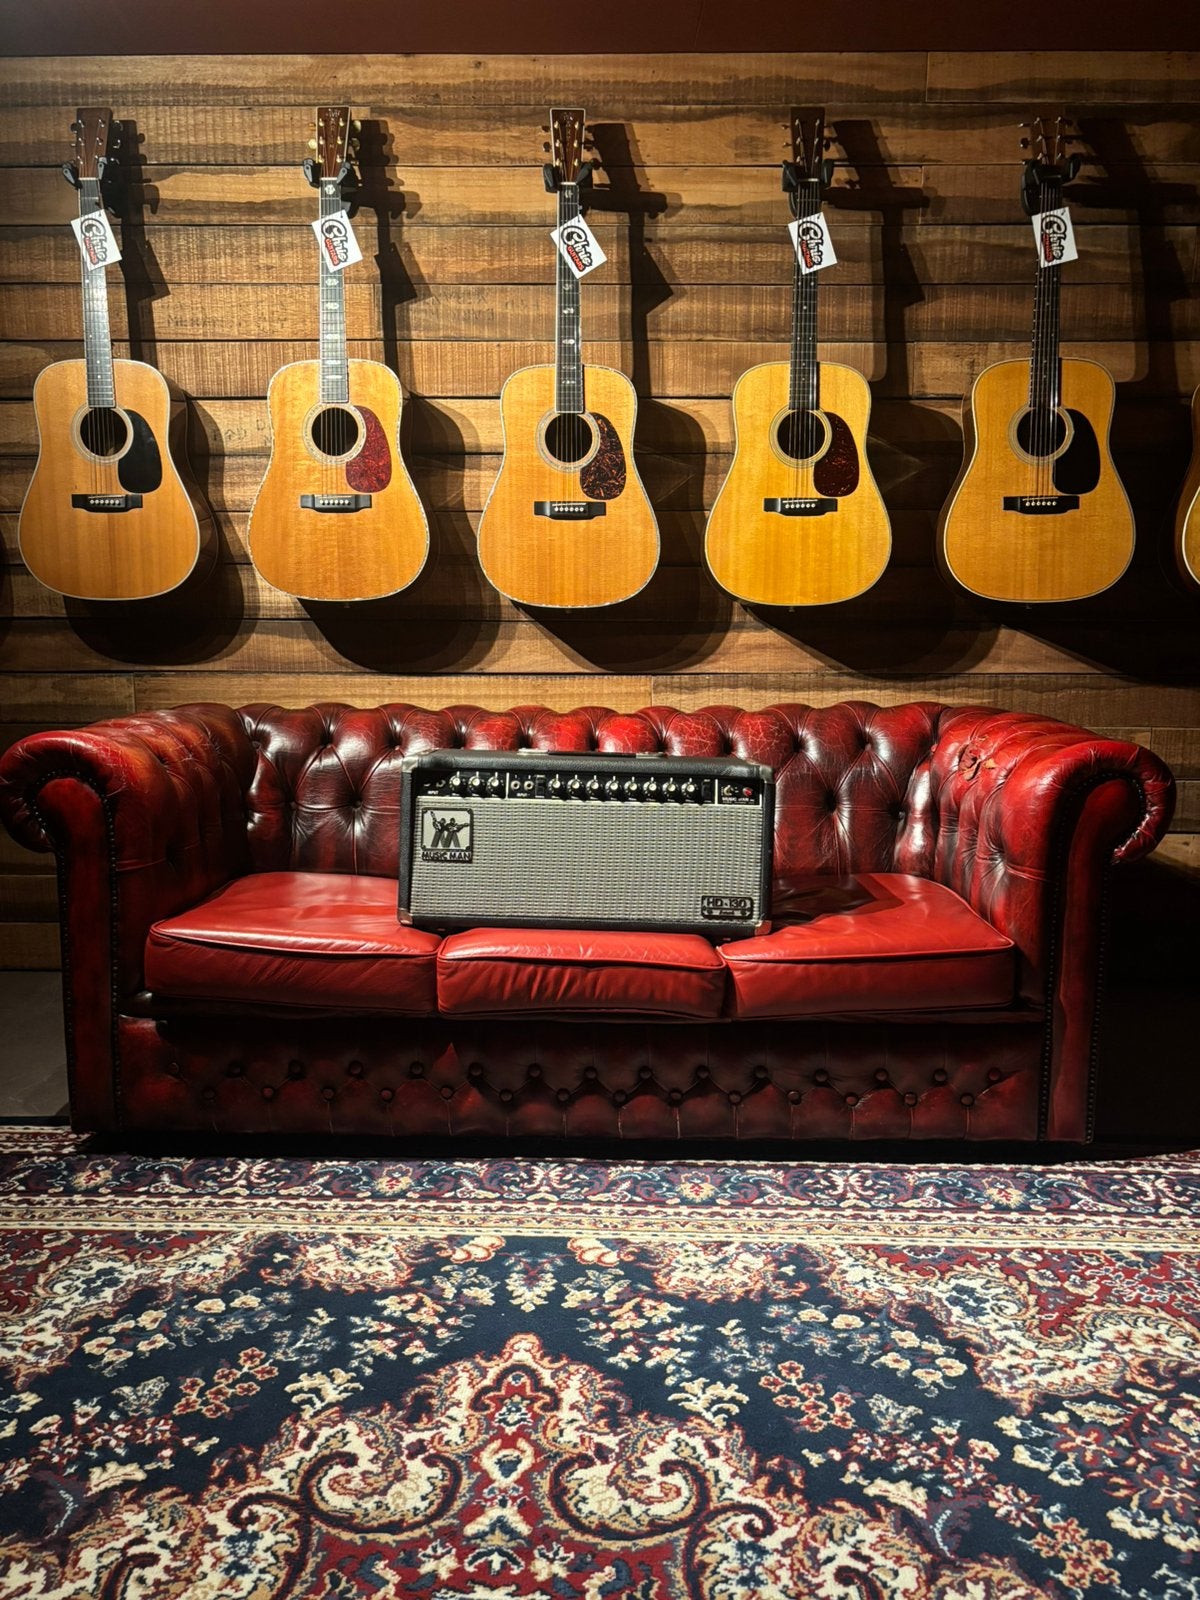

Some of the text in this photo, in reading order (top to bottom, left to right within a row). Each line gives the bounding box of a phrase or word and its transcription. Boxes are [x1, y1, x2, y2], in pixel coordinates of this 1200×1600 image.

[81, 218, 106, 264] Chris
[321, 218, 348, 262] Chris
[324, 238, 340, 267] GUITARS
[561, 226, 593, 267] Chris
[566, 244, 584, 272] GUITARS
[798, 219, 823, 265] Chris
[1042, 214, 1067, 260] Chris
[422, 851, 471, 861] MUSIC MAN
